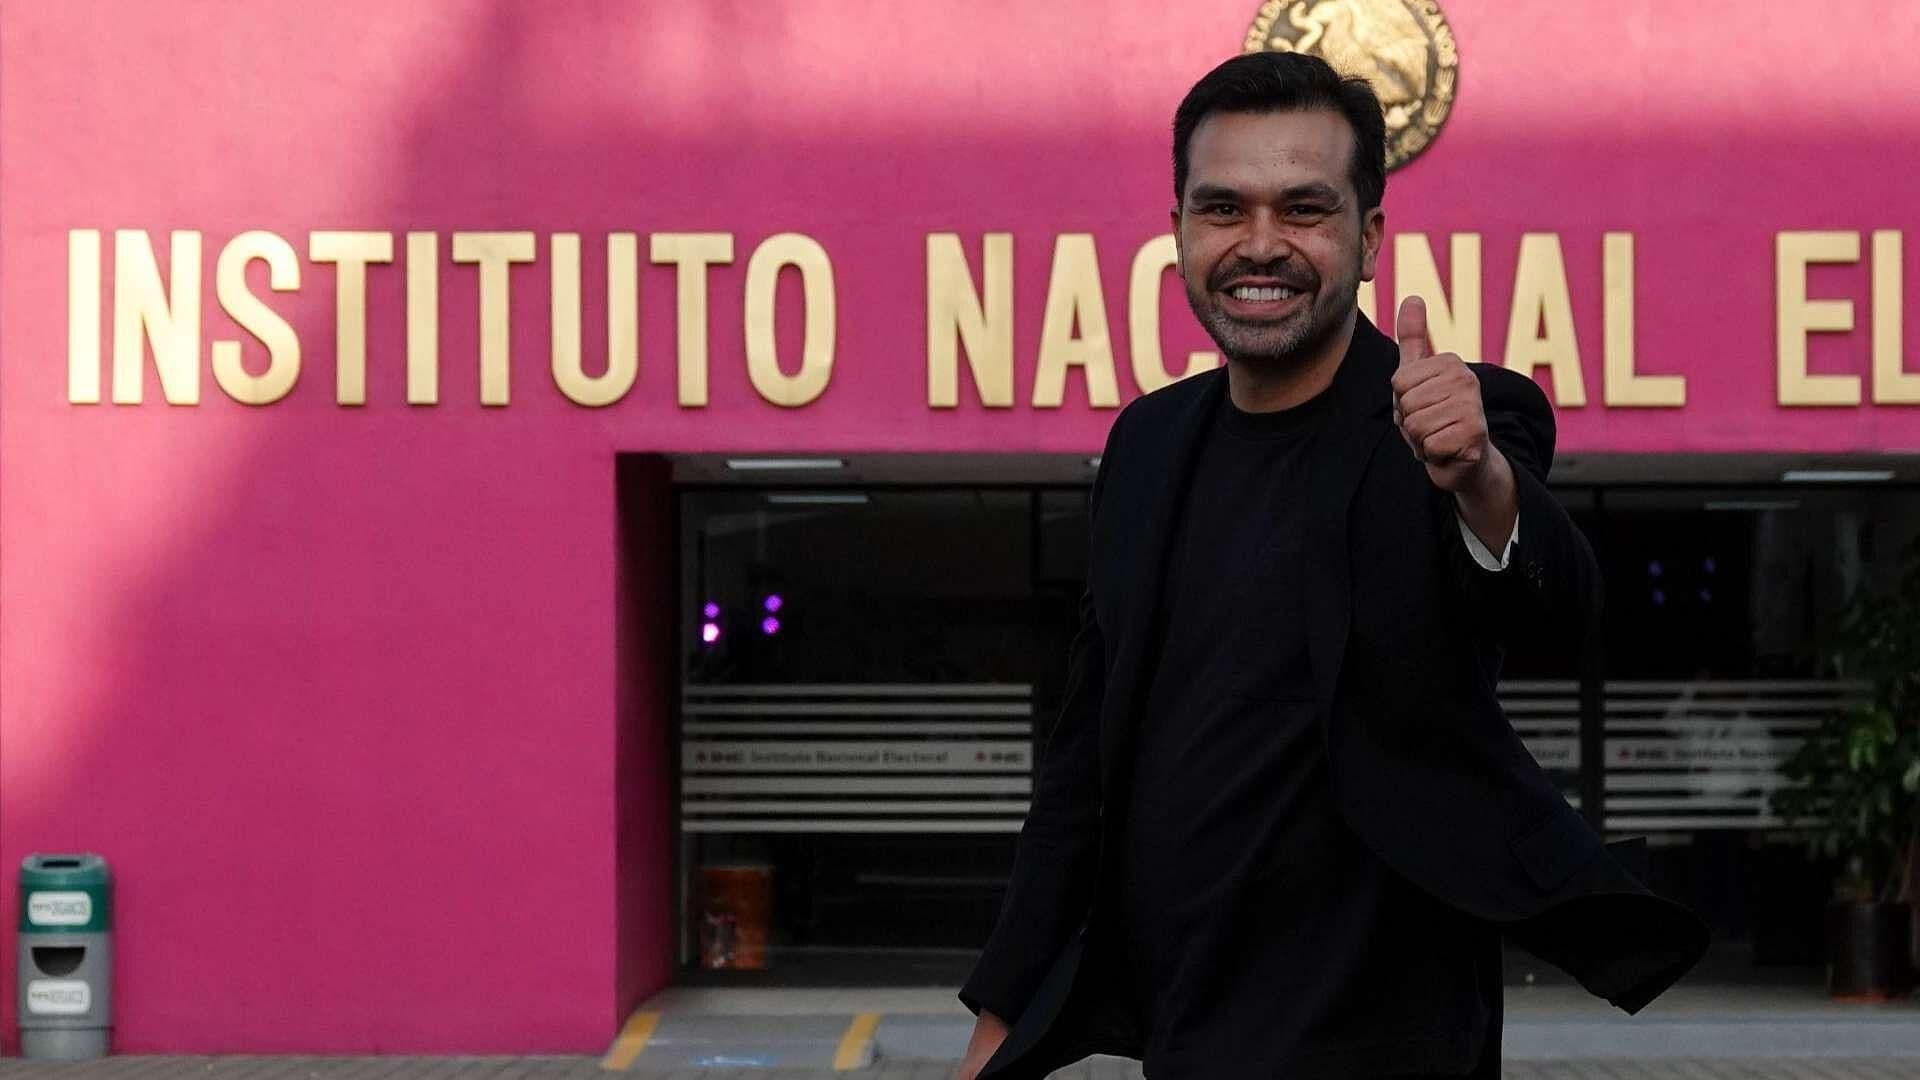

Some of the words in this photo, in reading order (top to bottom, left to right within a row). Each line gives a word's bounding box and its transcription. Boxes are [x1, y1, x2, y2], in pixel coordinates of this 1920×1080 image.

[67, 229, 836, 406] INSTITUTO
[927, 232, 1686, 407] NACNAL
[1776, 230, 1920, 405] EL
